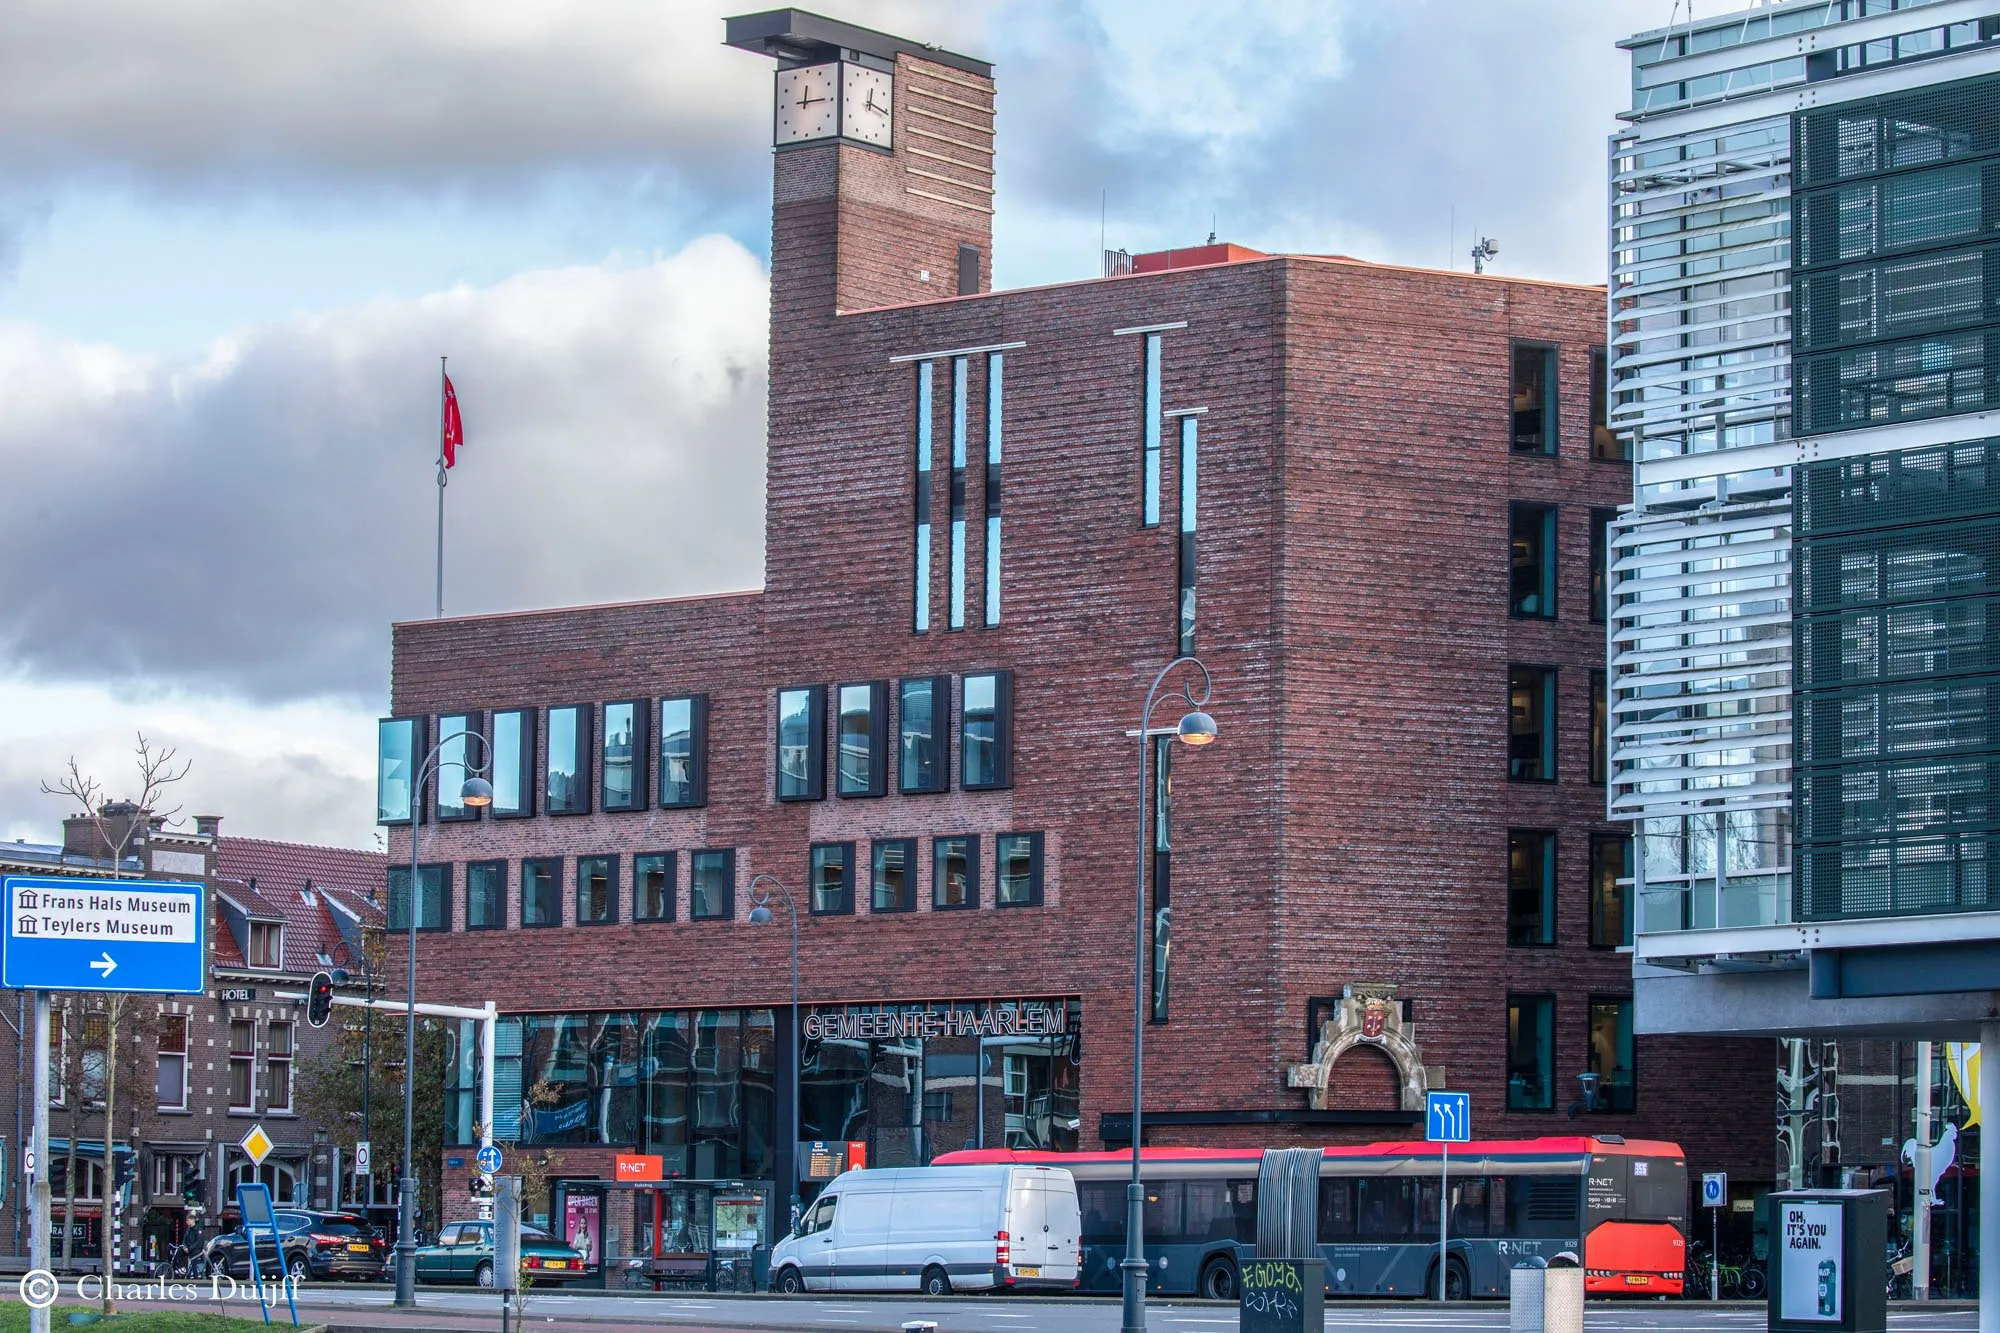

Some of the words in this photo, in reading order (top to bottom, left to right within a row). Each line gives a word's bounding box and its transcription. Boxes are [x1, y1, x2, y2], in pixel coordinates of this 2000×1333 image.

[42, 893, 84, 910] Frans
[89, 896, 122, 911] Hals
[128, 897, 191, 913] Museum
[41, 917, 100, 935] Teylers
[107, 919, 173, 935] Museum
[222, 989, 249, 1000] HOTEL
[804, 1011, 938, 1040] GEMEENTE
[944, 1008, 1064, 1036] HAARLEM
[1789, 1211, 1806, 1224] OH,
[1787, 1224, 1805, 1236] IT'S
[1807, 1224, 1826, 1236] YOU
[1672, 1239, 1684, 1247] 9329
[1789, 1237, 1821, 1249] AGAIN.
